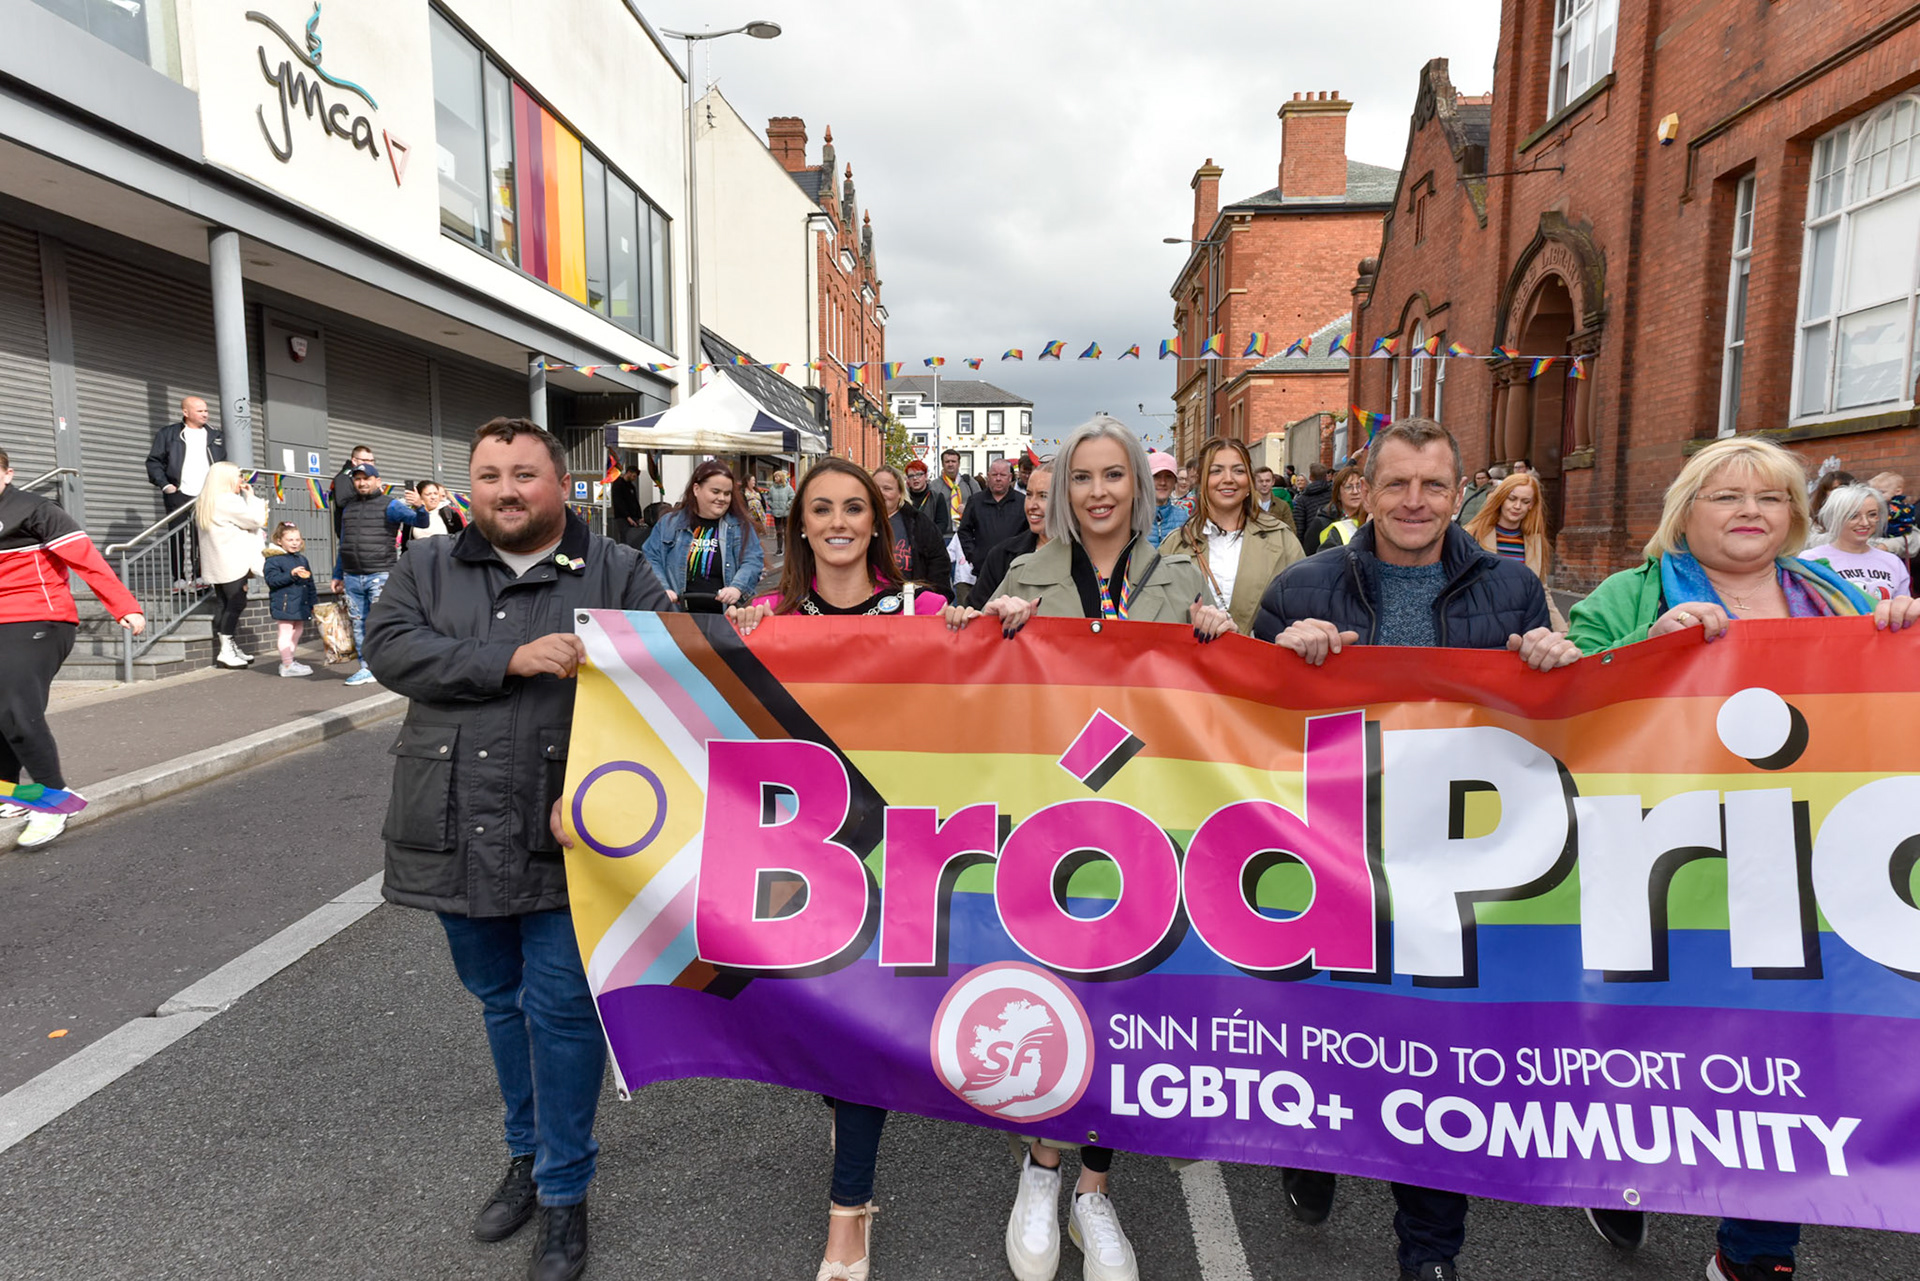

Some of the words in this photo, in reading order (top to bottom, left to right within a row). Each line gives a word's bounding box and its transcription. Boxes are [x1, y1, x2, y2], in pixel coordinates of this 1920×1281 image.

[256, 45, 380, 163] ymca
[1541, 247, 1582, 290] LIBRARY
[691, 538, 719, 547] RIDE
[1837, 568, 1866, 579] TRUE
[1867, 569, 1892, 581] LOVE
[985, 1040, 1041, 1077] SF
[1108, 1013, 1198, 1051] SINN
[1211, 1008, 1288, 1058] FÉIN
[1302, 1025, 1439, 1078] PROUD
[1449, 1046, 1506, 1087] TO
[1515, 1047, 1687, 1091] SUPPORT
[1700, 1053, 1807, 1098] OUR
[1110, 1062, 1354, 1132] LGBTQ+
[1380, 1088, 1863, 1177] COMMUNITY
